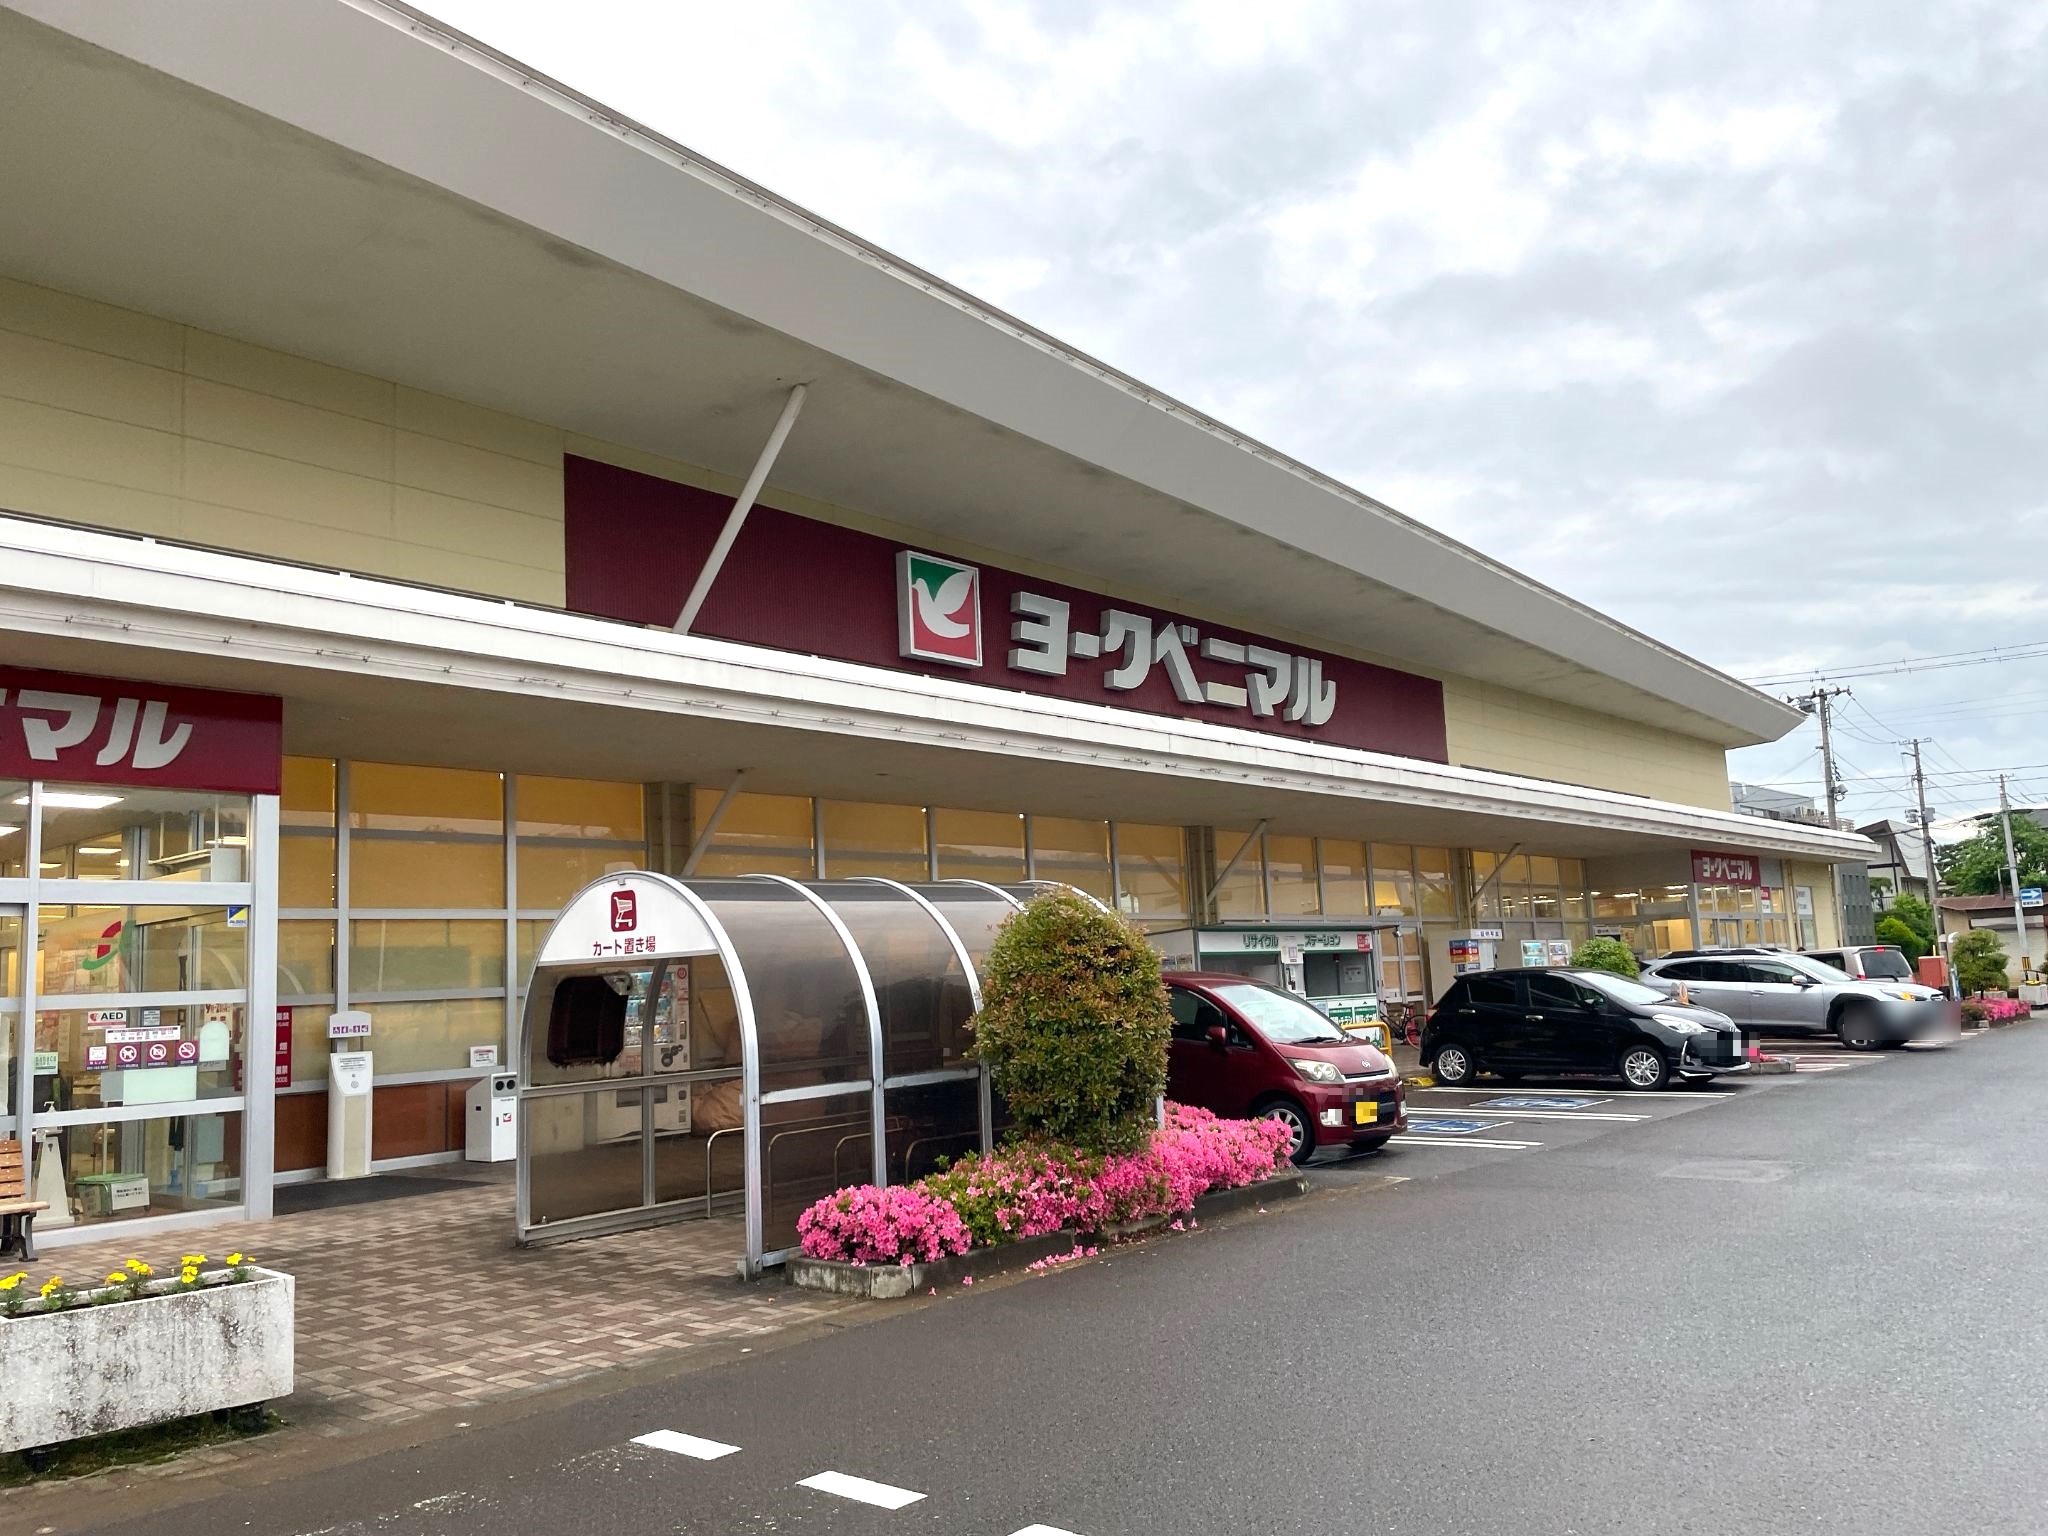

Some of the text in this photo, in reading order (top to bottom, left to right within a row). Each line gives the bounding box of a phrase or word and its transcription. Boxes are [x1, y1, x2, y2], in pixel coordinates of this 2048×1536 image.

[1008, 591, 1337, 726] ヨークベニマル
[0, 688, 193, 769] マル
[1702, 857, 1753, 881] ヨークベニマル
[593, 936, 656, 956] カート置き場
[1242, 933, 1279, 948] リサイクル
[1303, 933, 1341, 947] ステーション
[101, 1012, 124, 1021] AED
